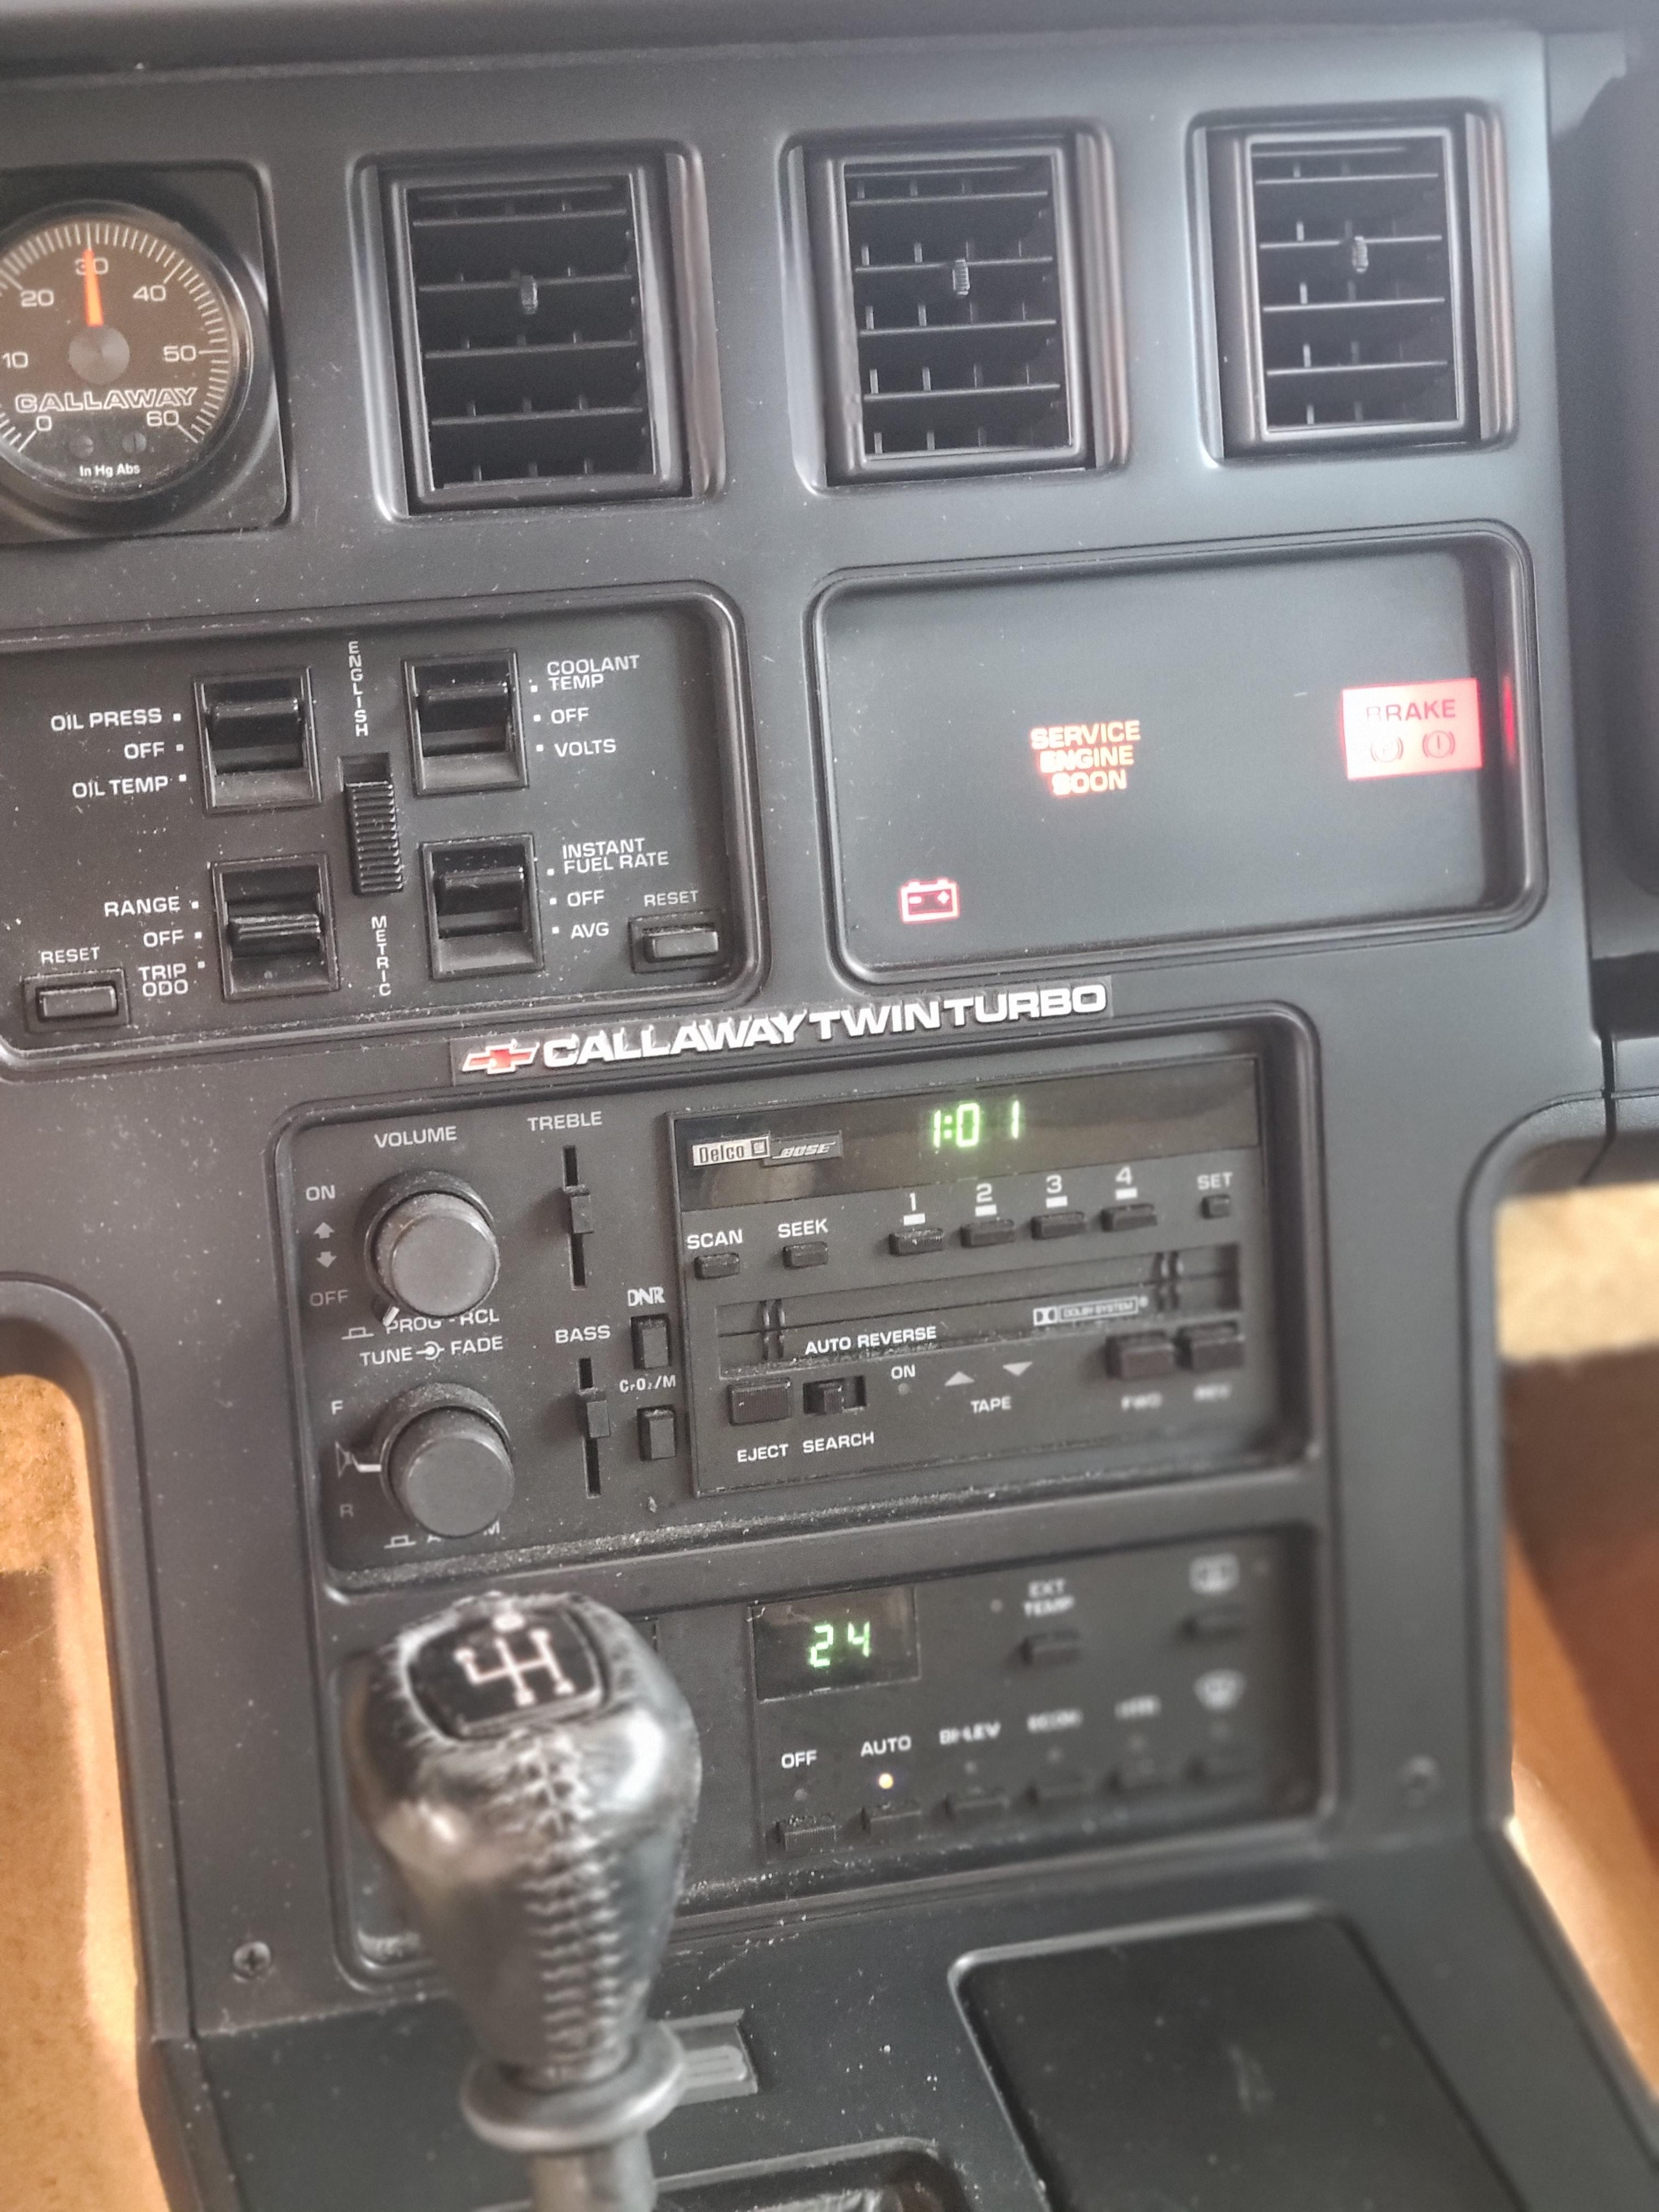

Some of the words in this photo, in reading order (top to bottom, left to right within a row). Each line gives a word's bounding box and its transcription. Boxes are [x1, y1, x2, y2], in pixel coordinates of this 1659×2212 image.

[75, 258, 108, 275] 30
[20, 290, 54, 307] 20
[132, 285, 166, 302] 40
[2, 352, 28, 368] 10
[163, 346, 196, 362] 50
[15, 387, 198, 413] CALLAWAY
[36, 416, 52, 431] 0
[146, 410, 179, 427] 60
[80, 465, 92, 477] In
[95, 465, 114, 478] Hg
[117, 464, 140, 475] Abs
[547, 654, 640, 677] COOLANT
[348, 641, 369, 737] ENGLISH
[549, 674, 604, 692] TEMP
[50, 714, 84, 731] OIL
[90, 708, 162, 728] PRESS
[551, 708, 589, 724] OFF
[1030, 720, 1141, 750] SERVICE
[124, 742, 165, 759] OFF
[554, 739, 616, 757] VOLTS
[1040, 745, 1134, 773] ENGINE
[72, 782, 105, 798] OIL
[109, 776, 168, 795] TEMP
[1051, 769, 1127, 796] SOON
[562, 837, 646, 859] INSTANT
[564, 856, 613, 874] FUEL
[619, 851, 669, 870] RATE
[104, 896, 180, 917] RANGE
[567, 889, 605, 906] OFF
[644, 890, 698, 907] RESET
[143, 930, 184, 947] OFF
[571, 922, 609, 938] AVG
[41, 947, 100, 964] RESET
[371, 915, 392, 996] METRIC
[139, 963, 187, 980] TRIP
[142, 979, 188, 997] ODO
[544, 1009, 808, 1067] CALLAWAY
[809, 1001, 941, 1040] TWIN
[943, 984, 1107, 1026] TURBO
[527, 1111, 603, 1132] TREBLE
[933, 1099, 1020, 1148] 1:01
[374, 1126, 457, 1149] VOLUME
[699, 1145, 744, 1164] Delco
[772, 1141, 836, 1159] BOSE
[1046, 1175, 1062, 1194] 3
[1115, 1166, 1132, 1186] 4
[1197, 1171, 1233, 1190] SET
[305, 1184, 336, 1201] ON
[910, 1193, 916, 1211] 1
[976, 1182, 993, 1203] 2
[778, 1218, 829, 1239] SEEK
[687, 1229, 743, 1250] SCAN
[310, 1289, 348, 1307] OFF
[628, 1287, 665, 1307] DNR
[555, 1325, 611, 1344] BASS
[805, 1336, 851, 1355] AUTO
[857, 1326, 937, 1348] REVERSE
[359, 1346, 413, 1367] TUNE
[450, 1335, 504, 1355] FADE
[891, 1364, 916, 1380] ON
[331, 1400, 343, 1415] F
[970, 1396, 1012, 1414] TAPE
[803, 1431, 875, 1454] SEARCH
[737, 1443, 789, 1463] EJECT
[340, 1504, 353, 1517] R
[810, 1621, 871, 1668] 24
[860, 1735, 912, 1757] AUTO
[781, 1749, 817, 1769] OFF
